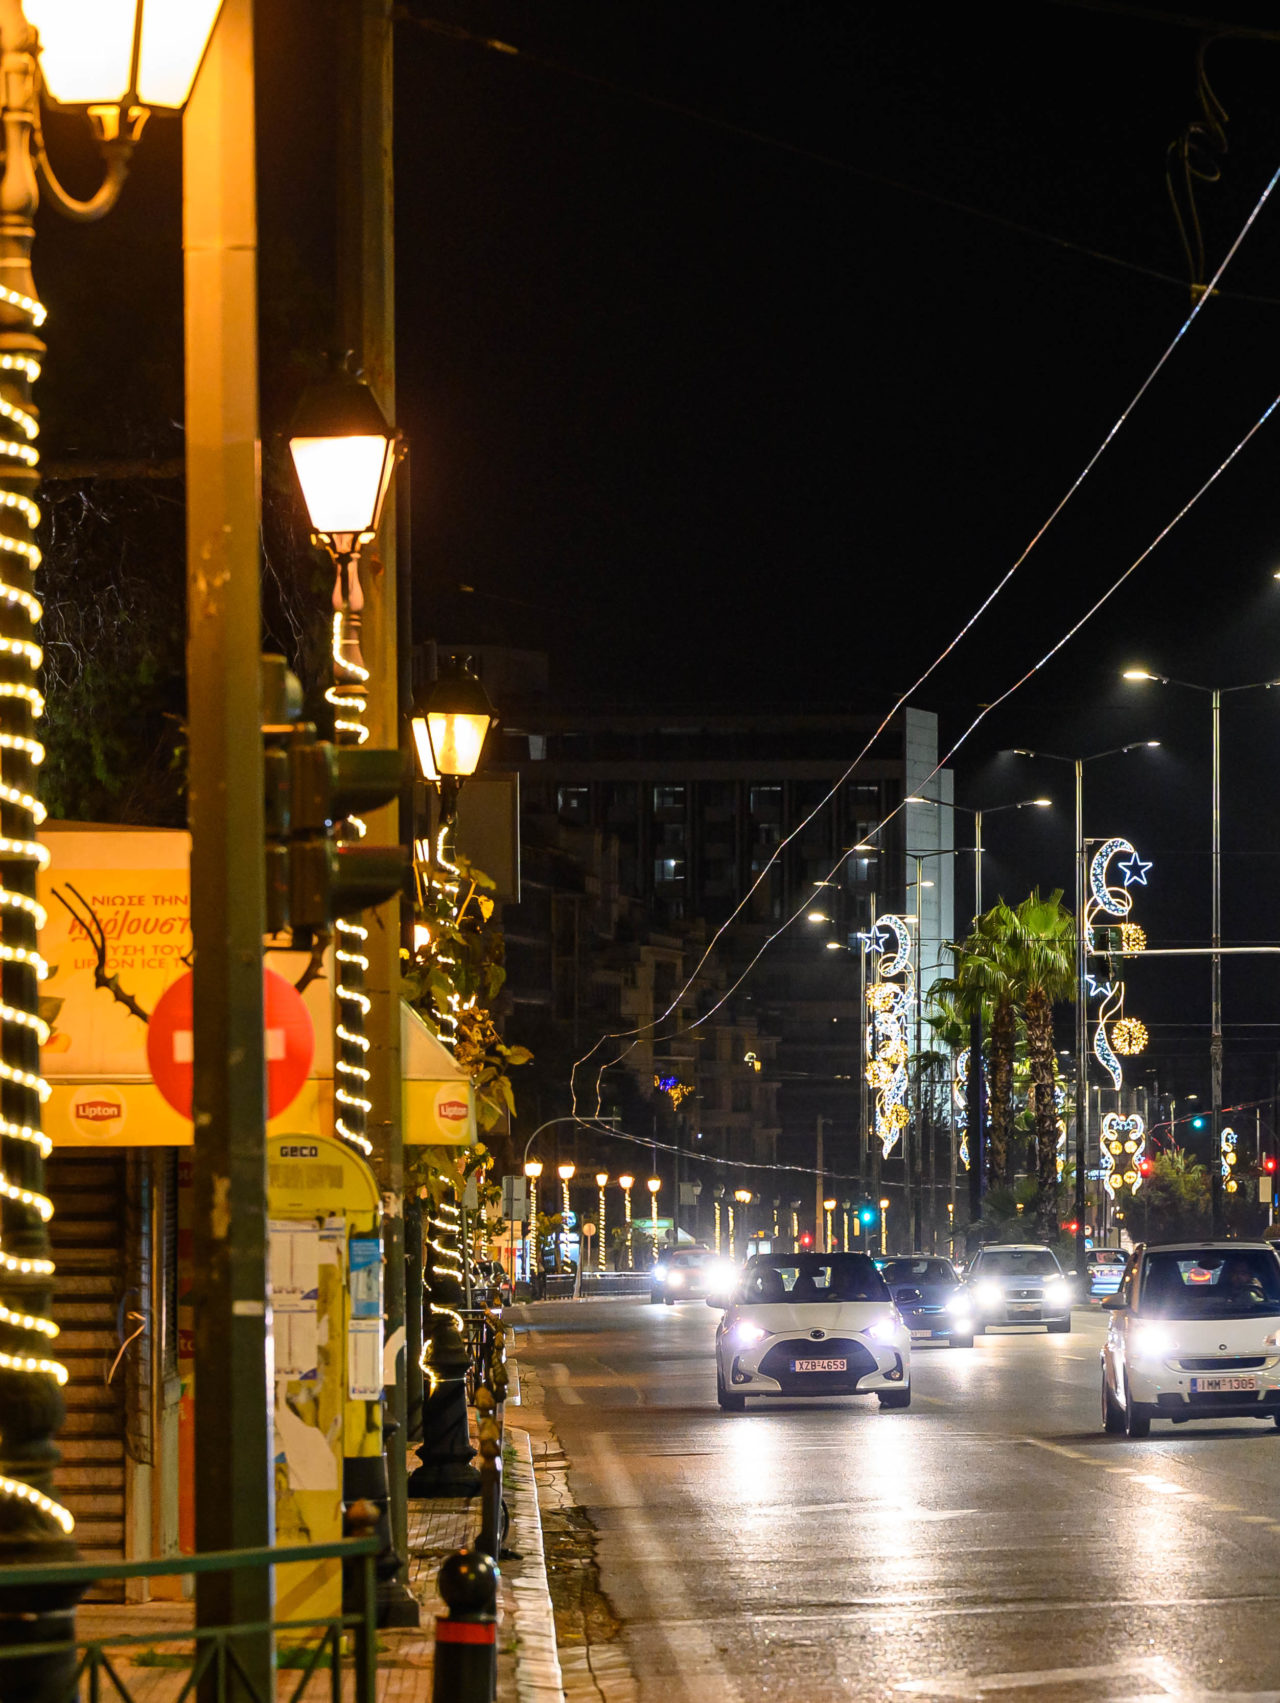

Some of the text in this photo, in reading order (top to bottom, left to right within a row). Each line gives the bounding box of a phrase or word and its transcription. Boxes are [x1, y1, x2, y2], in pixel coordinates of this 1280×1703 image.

[92, 895, 145, 906] ΝΙΩΣΕ
[74, 958, 135, 969] LIPON
[78, 1105, 118, 1118] Lipton
